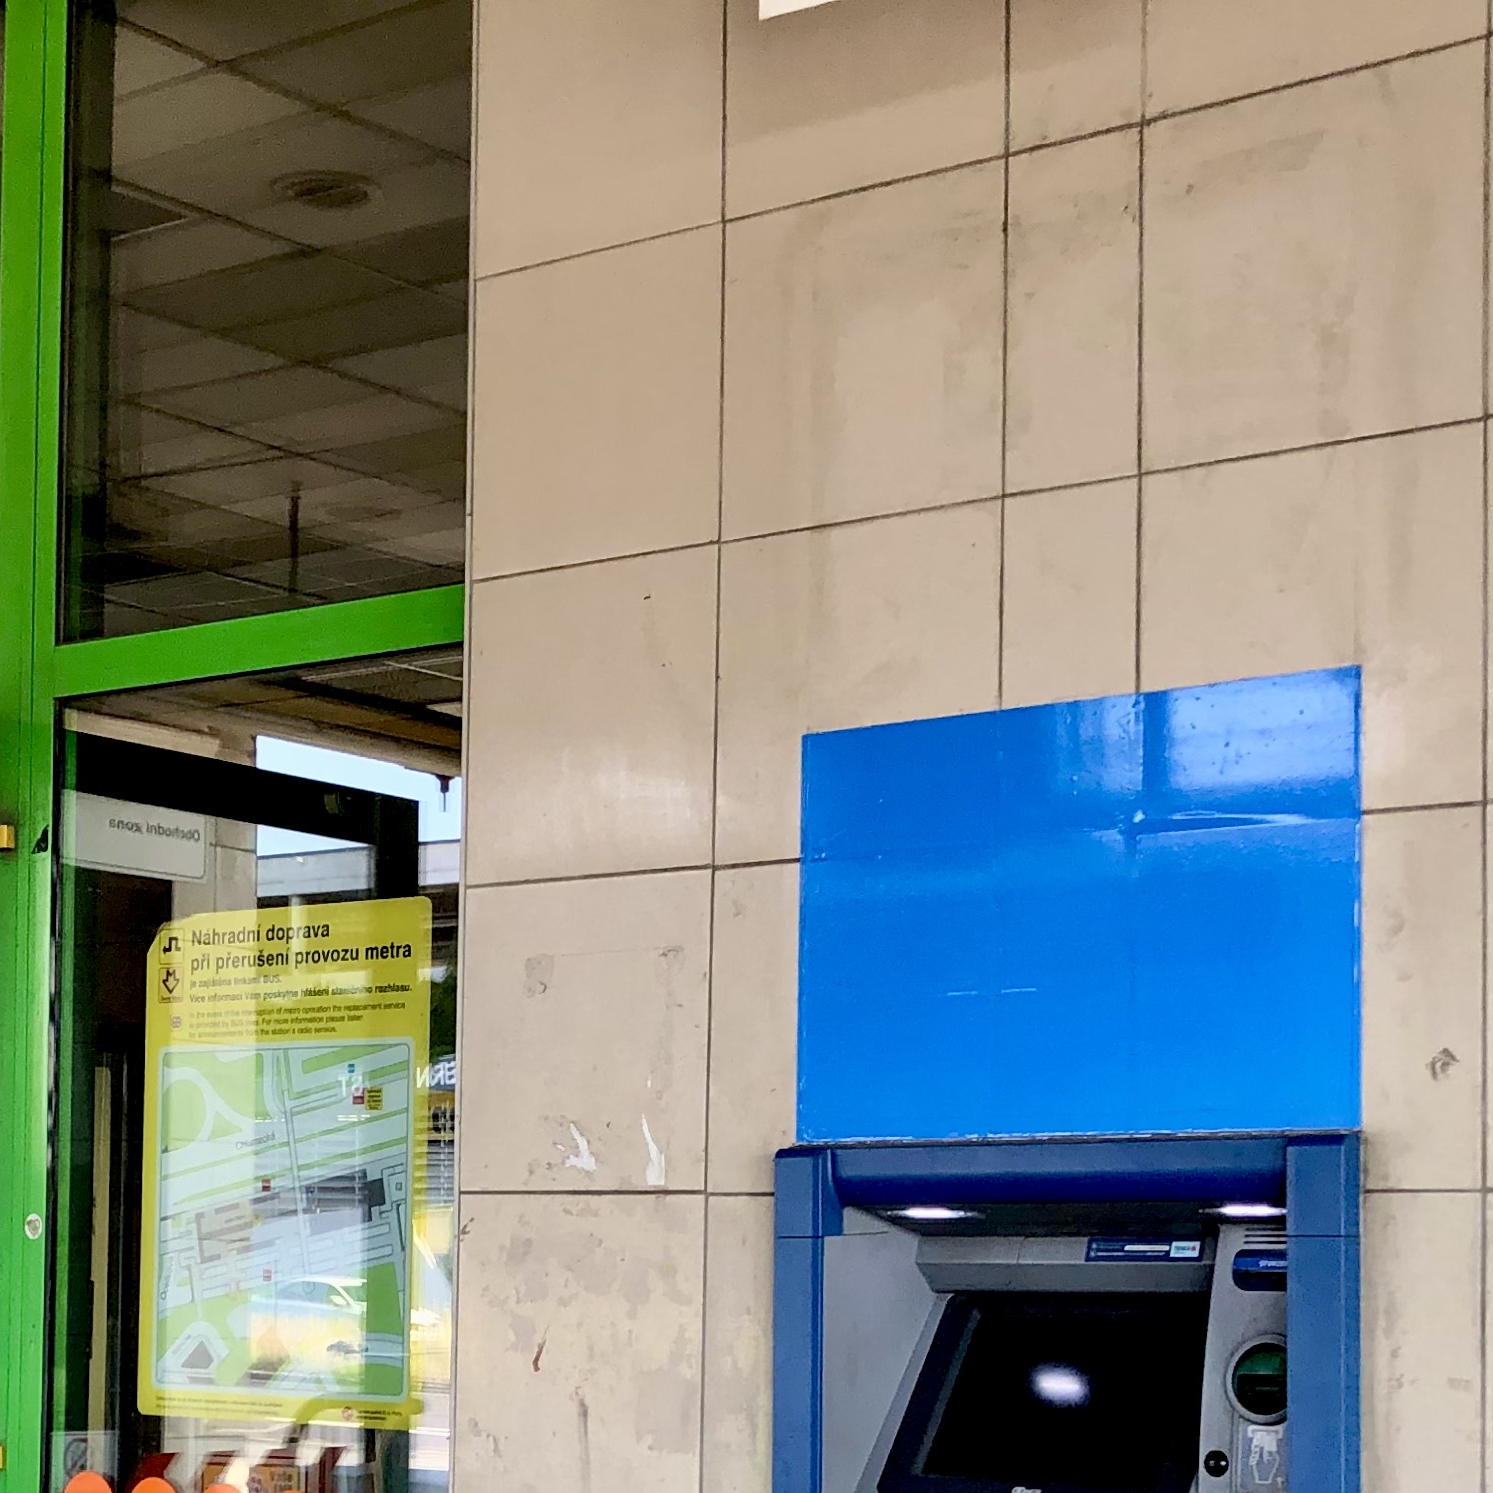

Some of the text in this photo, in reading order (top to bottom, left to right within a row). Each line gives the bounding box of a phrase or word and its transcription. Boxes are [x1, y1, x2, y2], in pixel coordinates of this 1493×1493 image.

[191, 923, 330, 947] Náhradní doprava
[190, 941, 412, 976] při přerušení provozu metra
